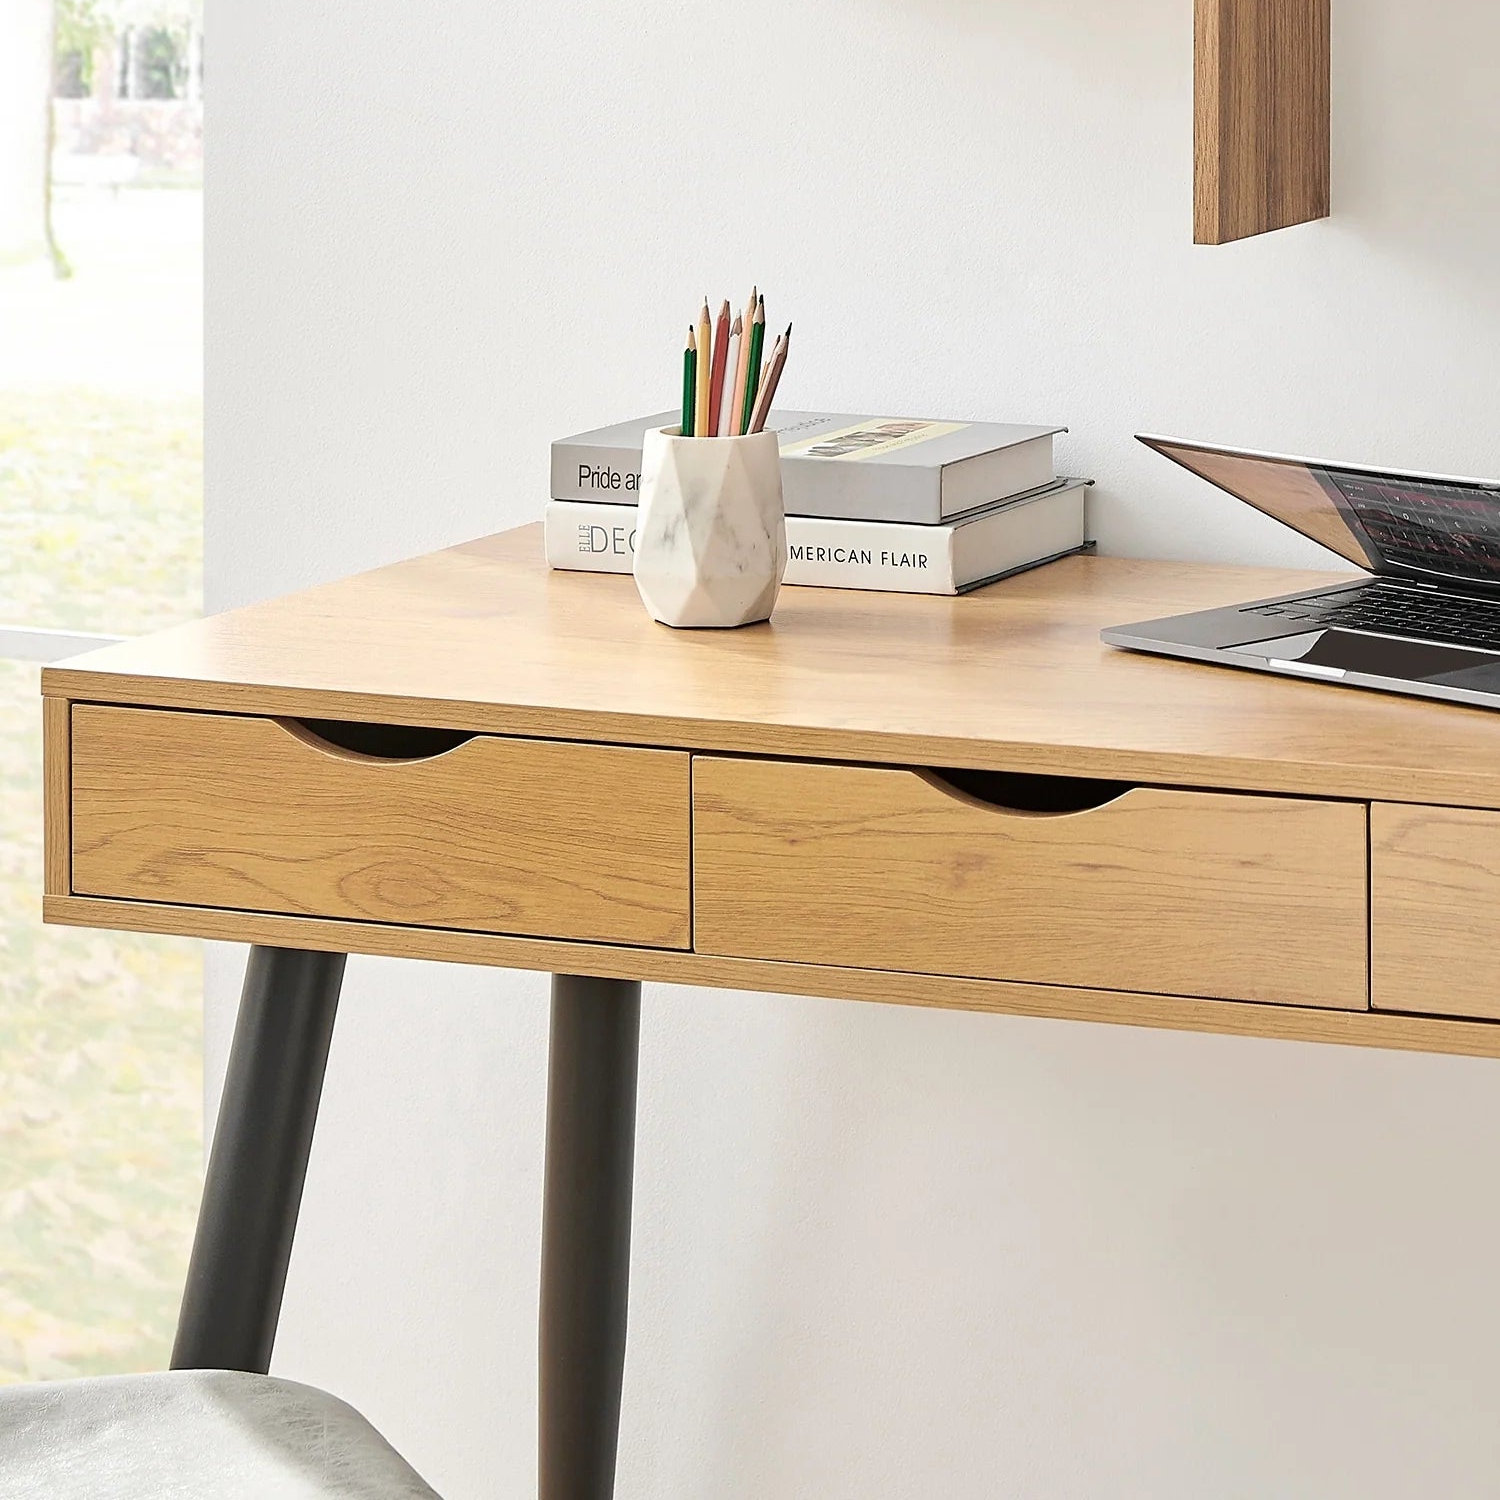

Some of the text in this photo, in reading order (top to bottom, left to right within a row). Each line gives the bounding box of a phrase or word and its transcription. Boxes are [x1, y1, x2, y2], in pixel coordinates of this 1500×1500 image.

[578, 464, 621, 490] Pride
[578, 524, 591, 553] ELLE
[790, 545, 928, 569] MERICAN FLAIR
